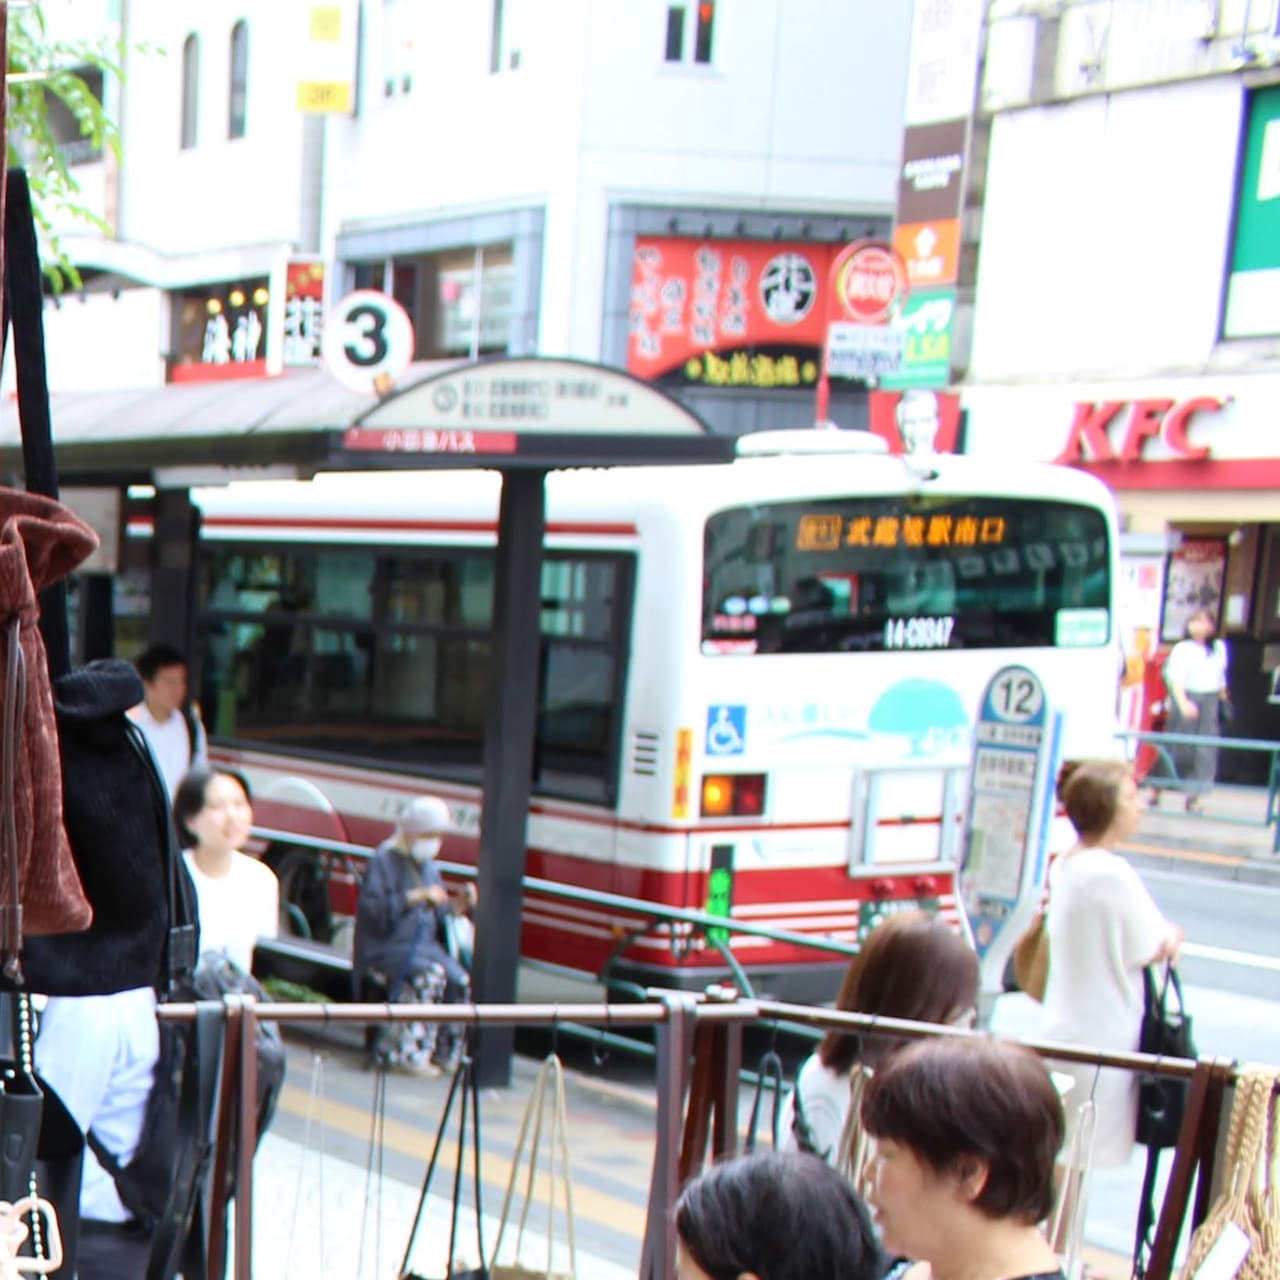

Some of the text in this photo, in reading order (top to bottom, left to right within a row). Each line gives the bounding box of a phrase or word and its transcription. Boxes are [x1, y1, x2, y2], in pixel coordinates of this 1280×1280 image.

[344, 305, 388, 366] 3
[1058, 398, 1224, 463] KFC
[997, 679, 1036, 716] 12
